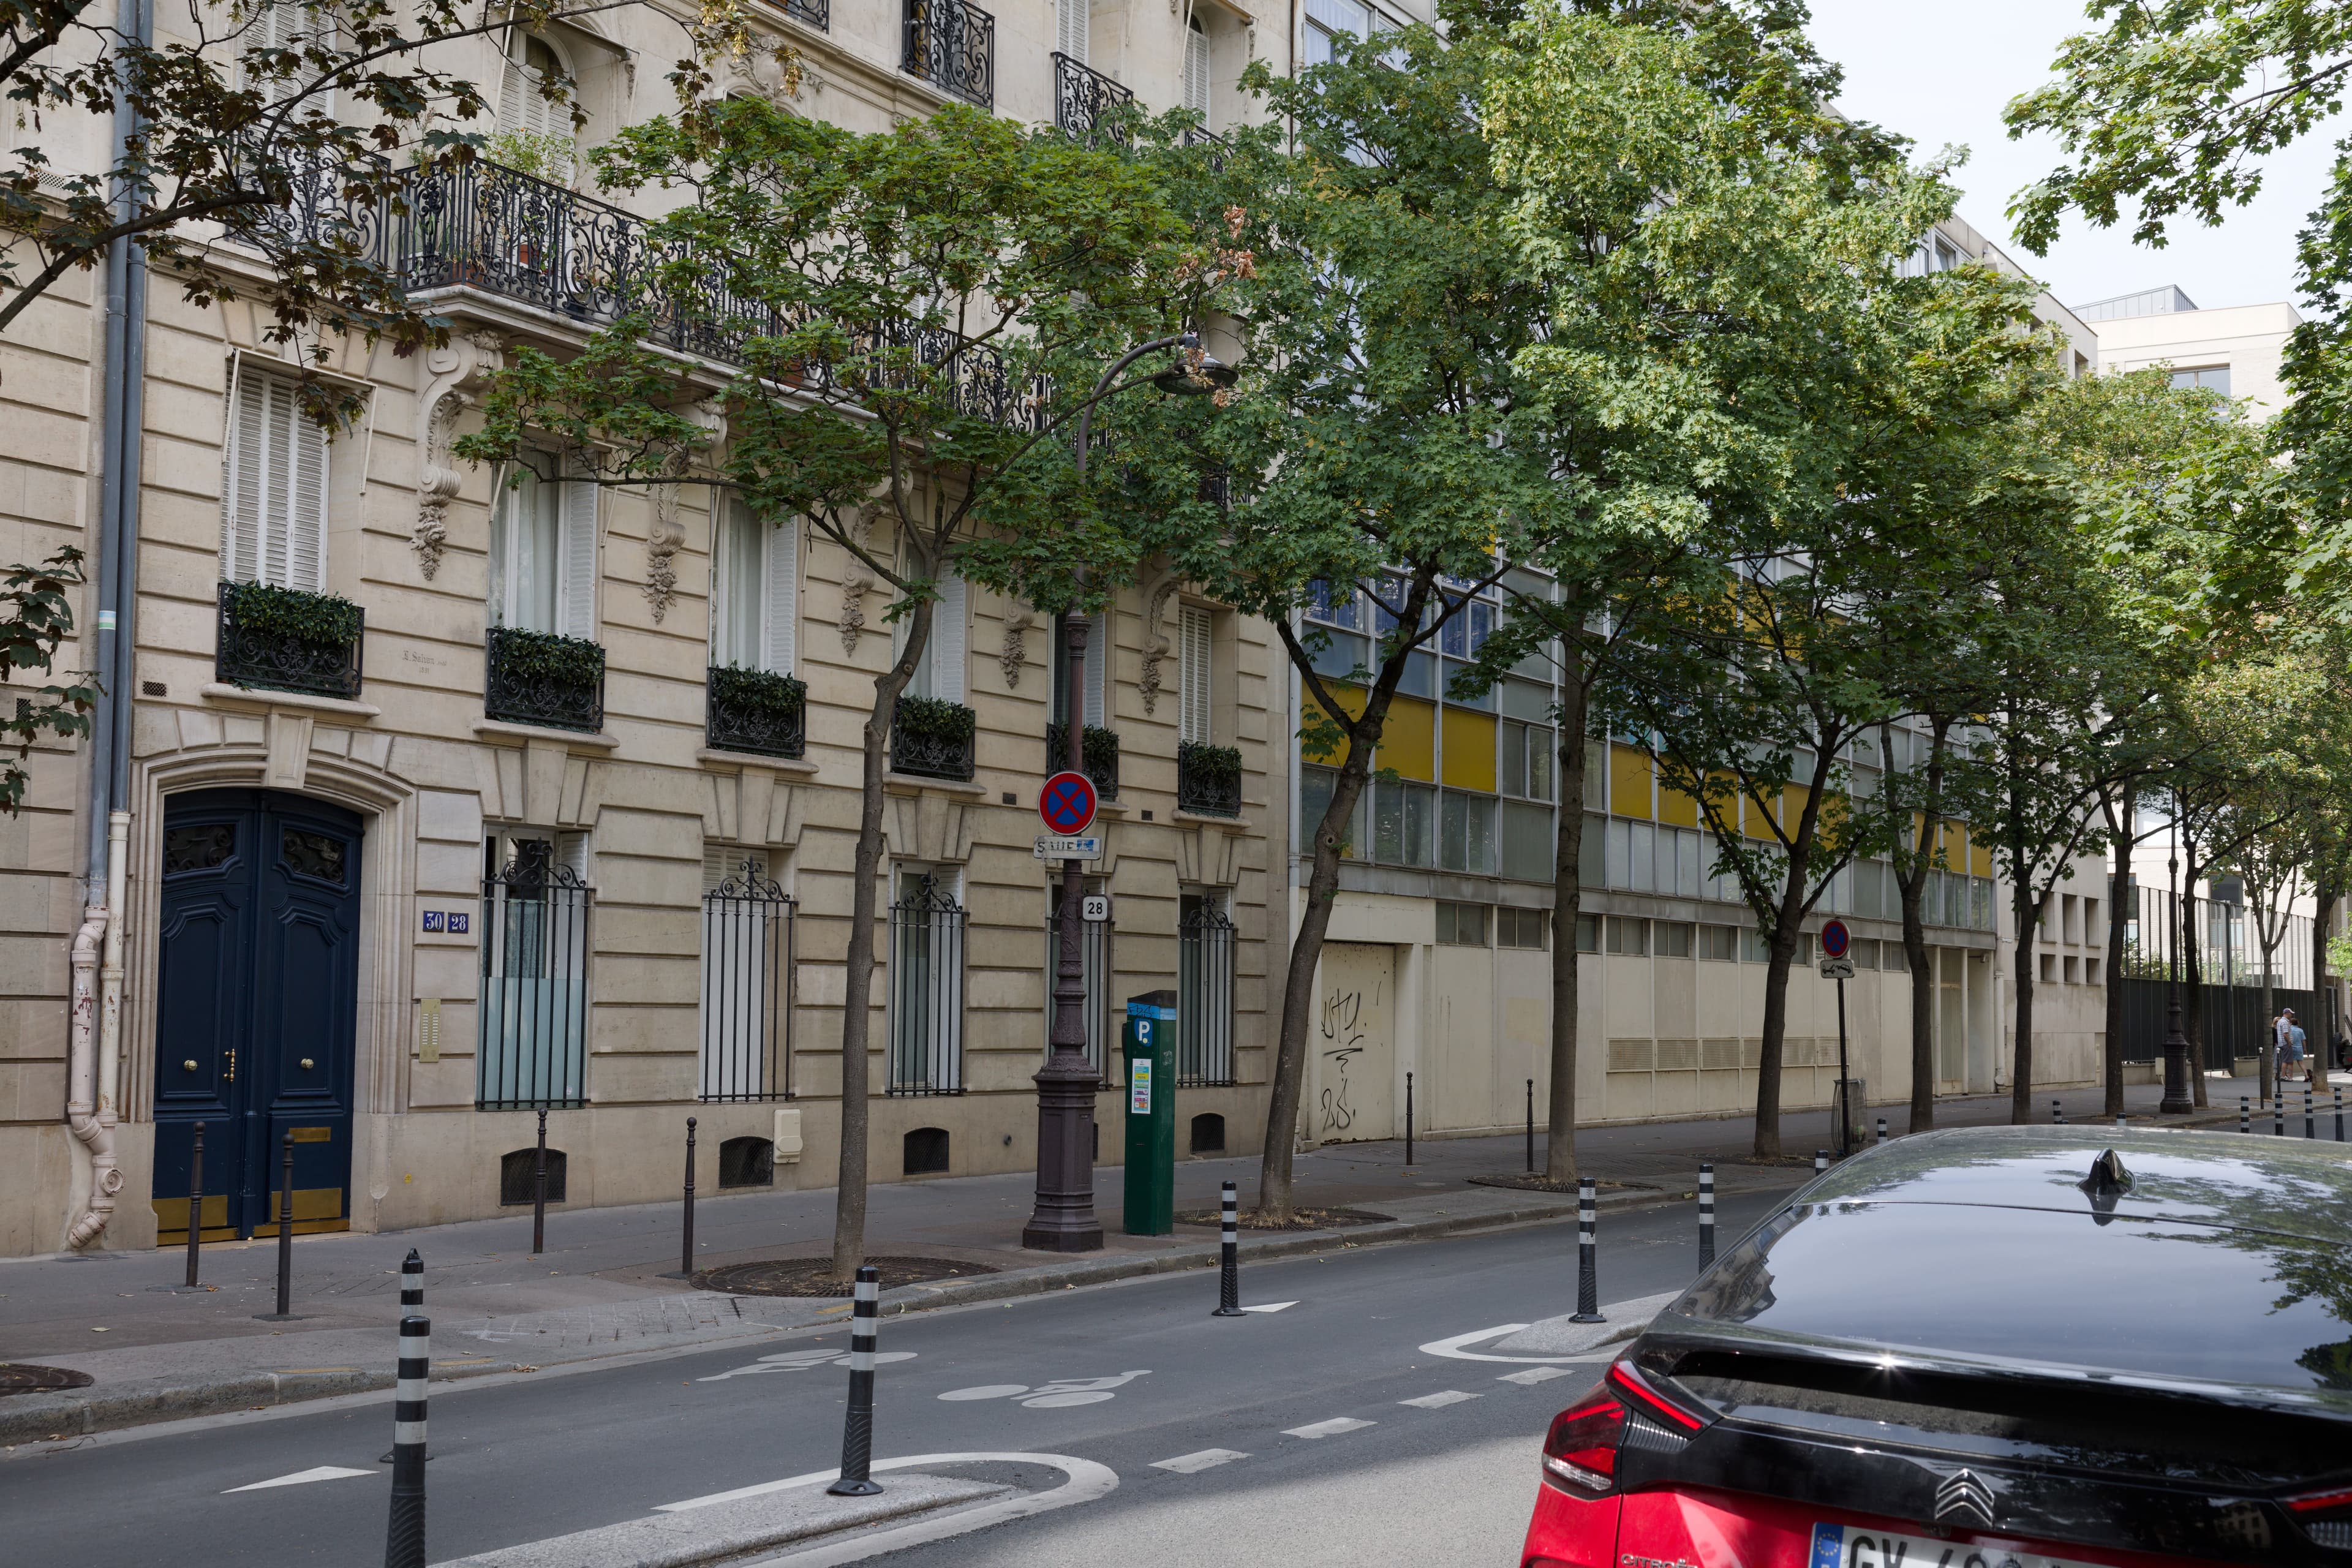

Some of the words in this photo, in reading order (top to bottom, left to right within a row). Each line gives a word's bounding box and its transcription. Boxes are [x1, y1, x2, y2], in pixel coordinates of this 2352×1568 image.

[1087, 902, 1102, 914] 28
[426, 913, 442, 930] 30
[451, 915, 466, 930] 28
[1139, 1021, 1150, 1041] P
[1621, 1553, 1698, 1568] CITROË
